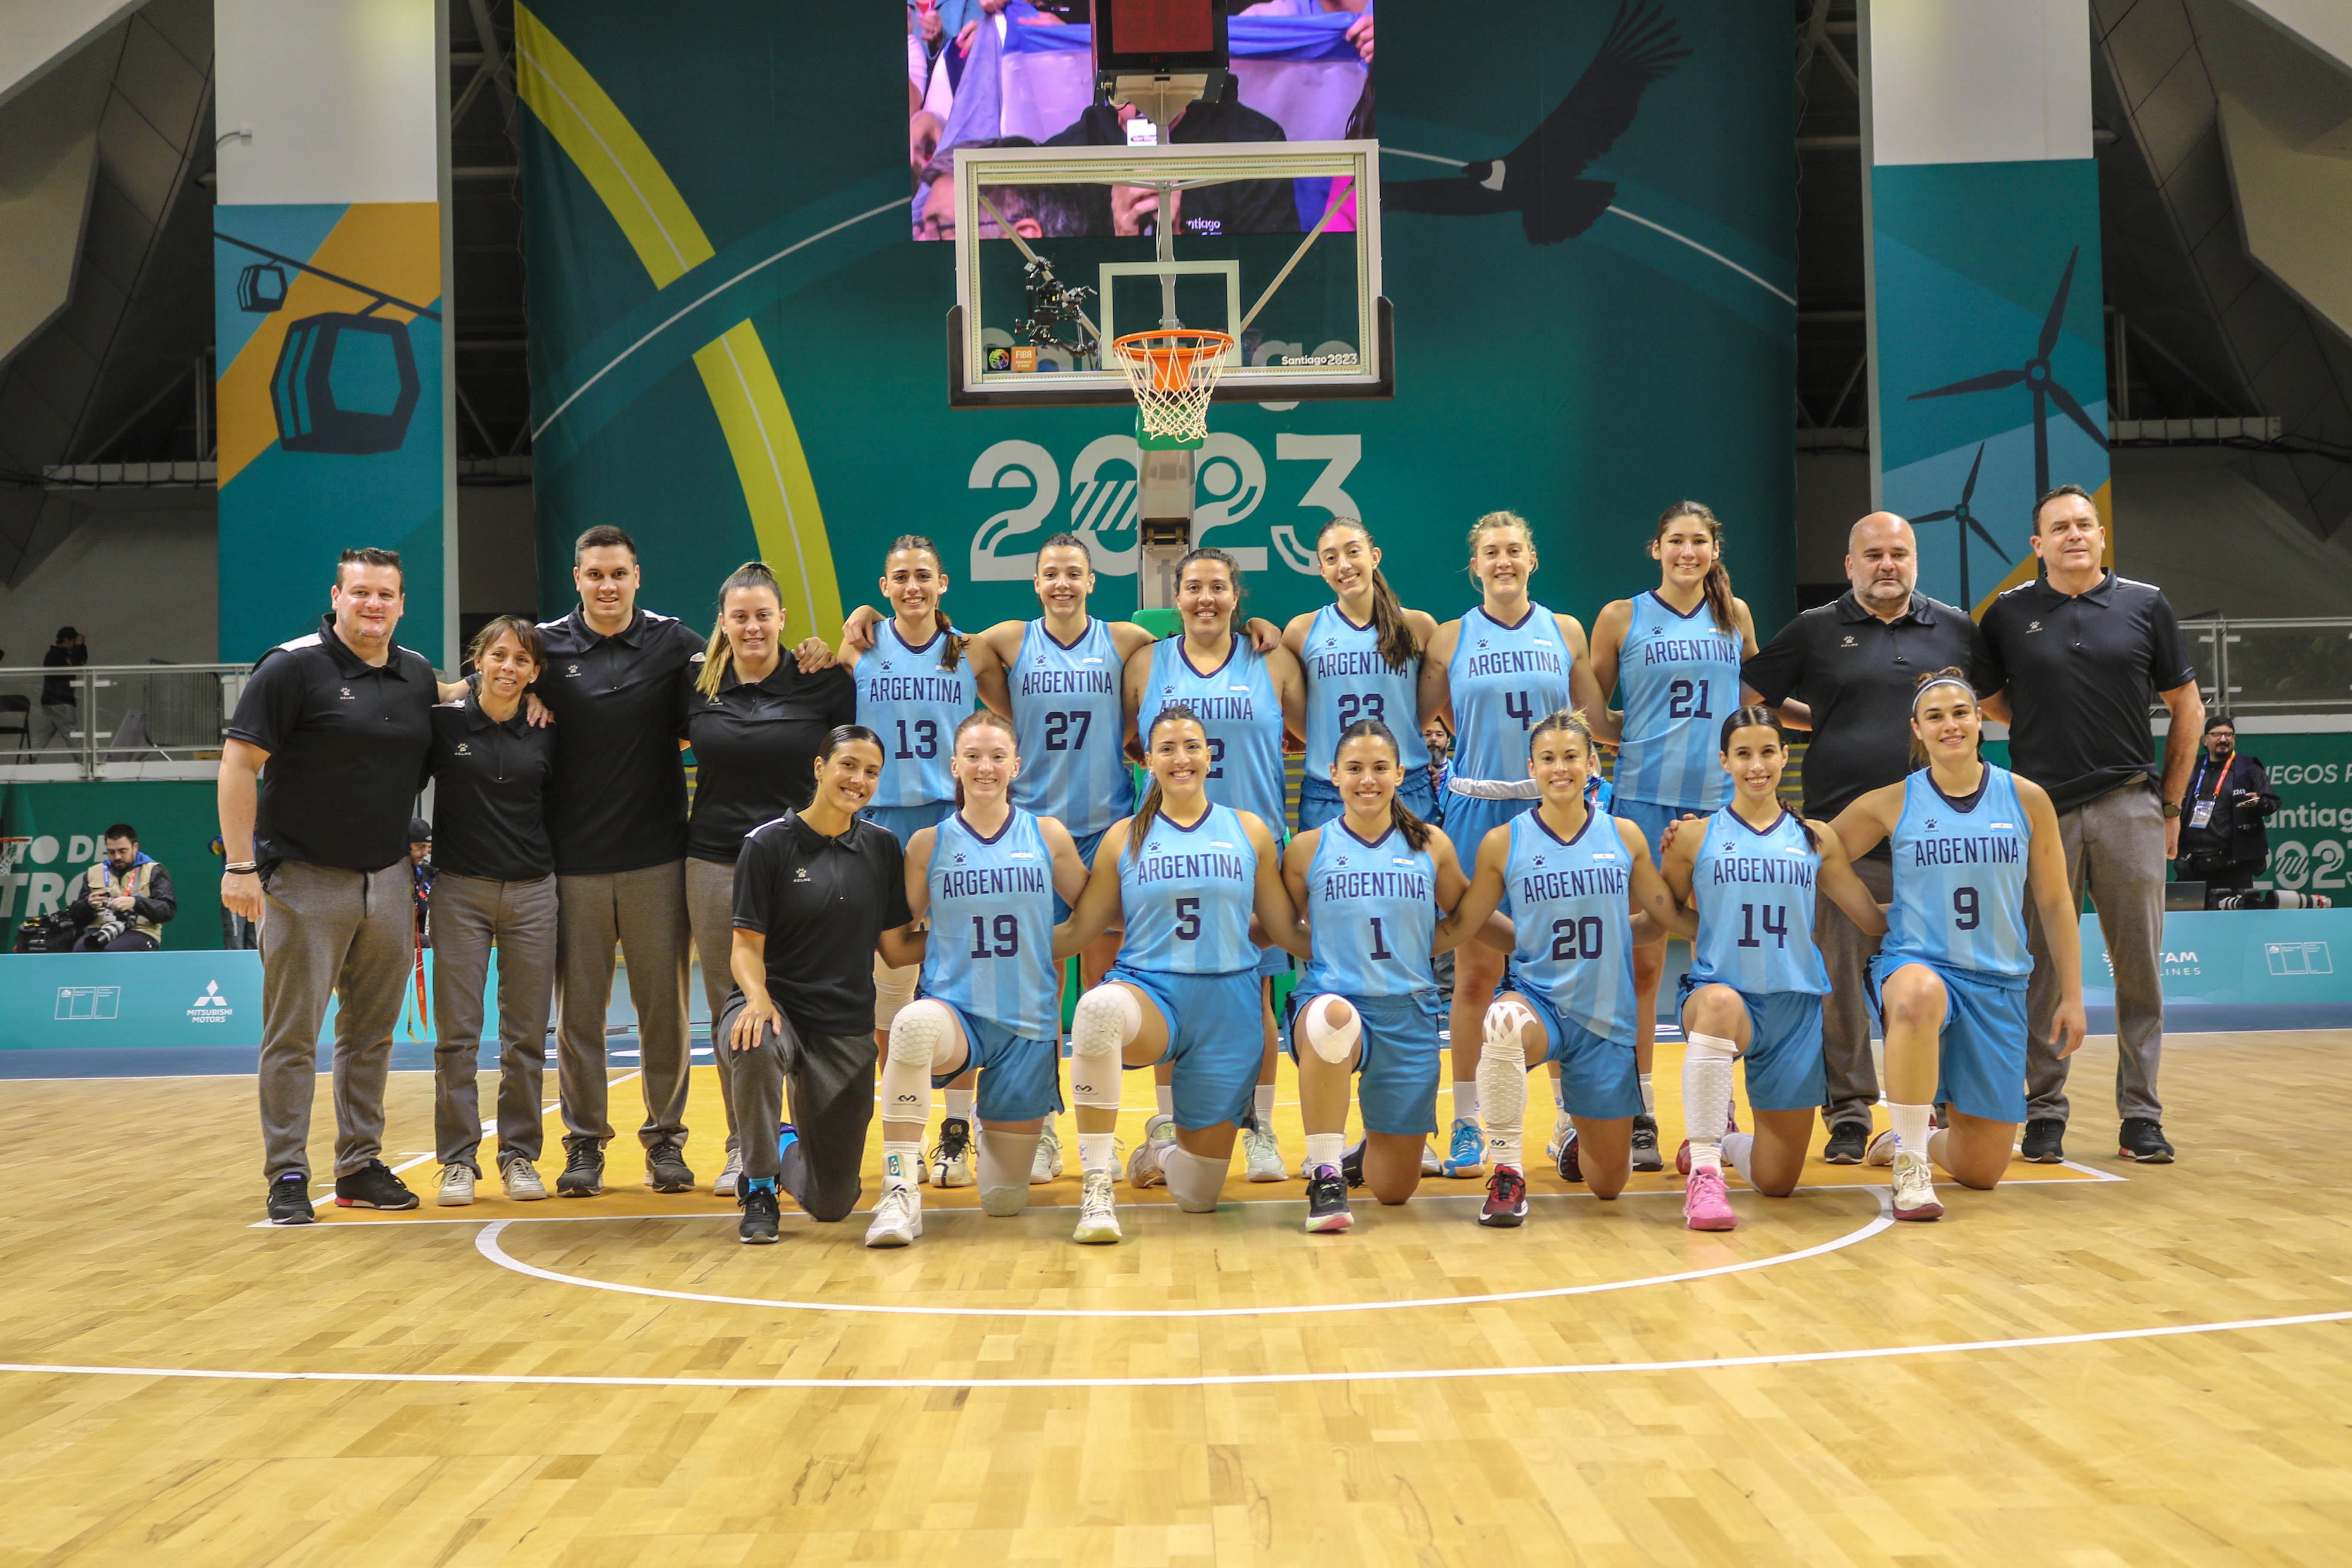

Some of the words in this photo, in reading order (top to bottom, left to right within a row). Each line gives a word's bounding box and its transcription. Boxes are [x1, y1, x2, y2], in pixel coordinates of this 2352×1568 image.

[1016, 350, 1032, 358] FIBA
[968, 432, 1362, 581] 2023
[1469, 651, 1562, 676] ARGENTINA
[1645, 640, 1736, 666] ARGENTINA
[870, 677, 961, 705] ARGENTINA
[1022, 671, 1113, 696] ARGENTINA
[1670, 680, 1712, 719] 21
[1338, 693, 1384, 733] 23
[1506, 691, 1533, 730] 4
[895, 720, 937, 759] 13
[1045, 711, 1091, 750] 27
[1206, 738, 1225, 778] 2
[1138, 854, 1243, 885] ARGENTINA
[1916, 837, 2018, 867] ARGENTINA
[943, 867, 1044, 900] ARGENTINA
[1325, 873, 1426, 902] ARGENTINA
[1524, 868, 1623, 904] ARGENTINA
[1714, 858, 1811, 891] ARGENTINA
[1176, 897, 1200, 940] 5
[1738, 904, 1787, 948] 14
[1954, 887, 1979, 930] 9
[971, 915, 1018, 959] 19
[1370, 918, 1391, 960] 1
[1553, 916, 1602, 961] 20
